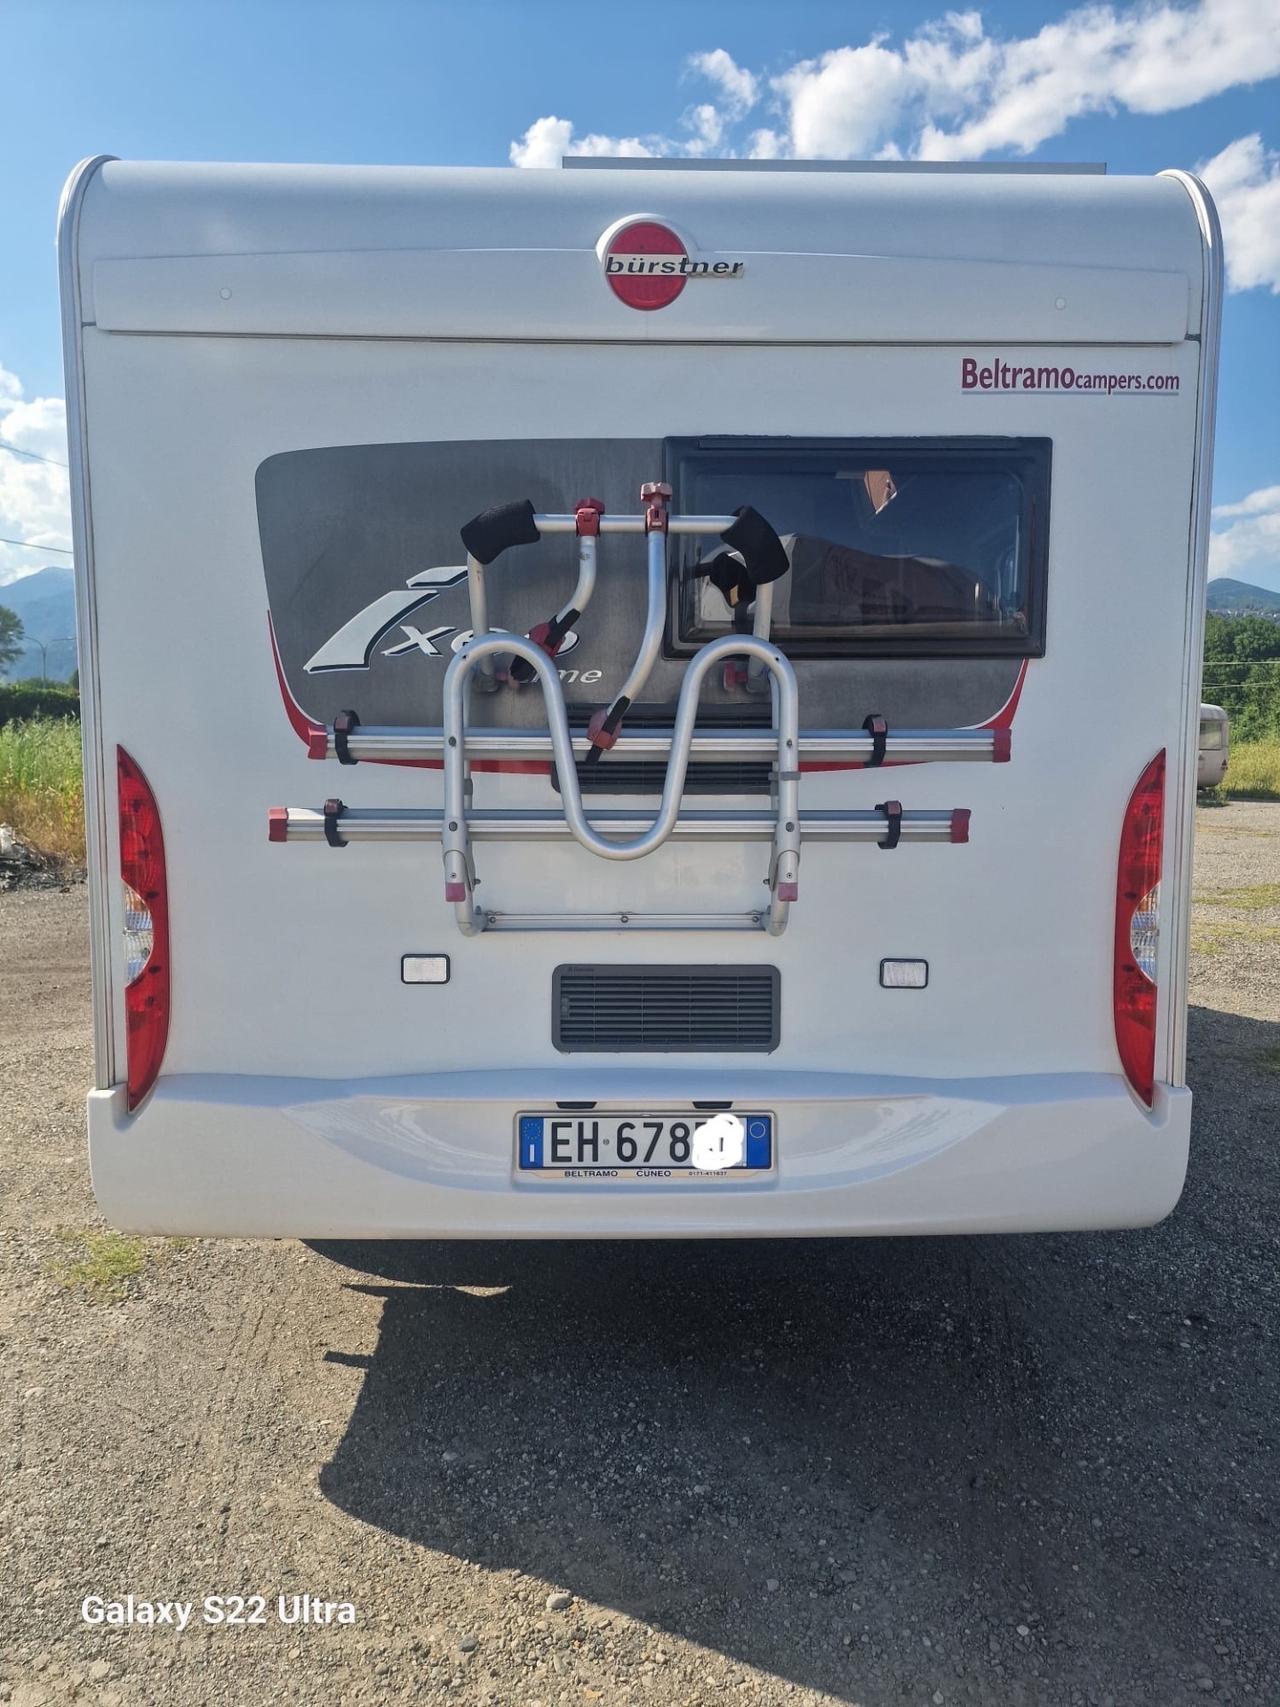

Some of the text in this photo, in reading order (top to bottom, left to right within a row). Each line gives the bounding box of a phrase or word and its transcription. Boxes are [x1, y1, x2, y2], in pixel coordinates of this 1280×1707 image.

[606, 257, 744, 274] bürstner
[551, 1121, 741, 1163] EH 678
[564, 1170, 619, 1178] BELTRAMO
[636, 1170, 672, 1178] CUNEO
